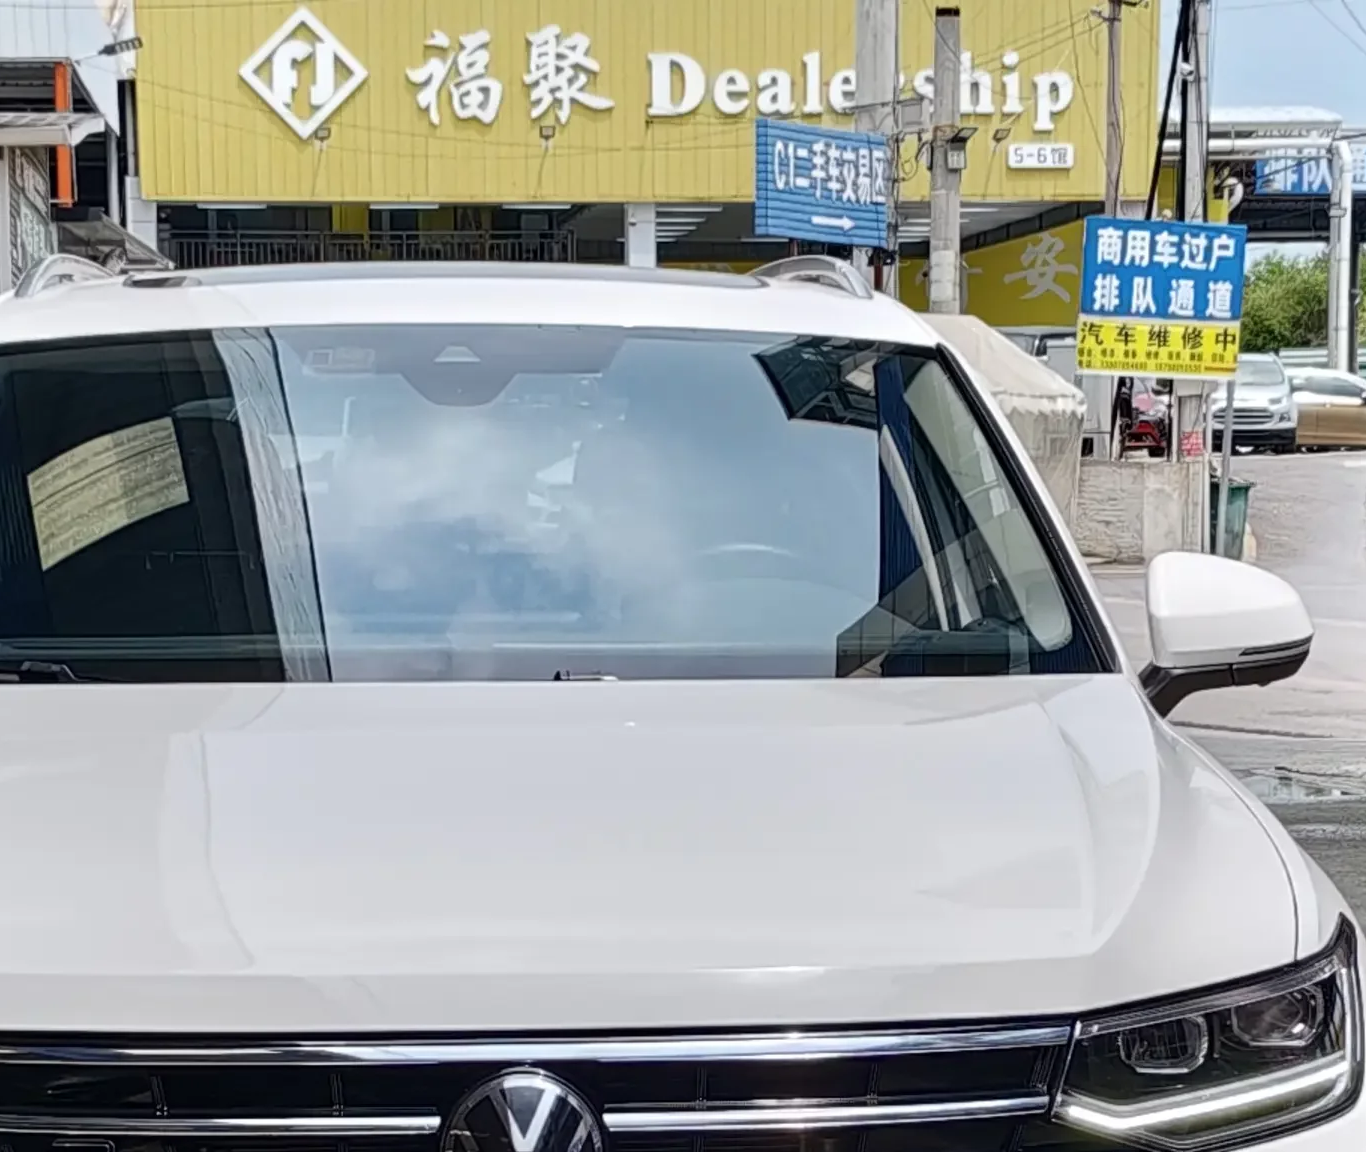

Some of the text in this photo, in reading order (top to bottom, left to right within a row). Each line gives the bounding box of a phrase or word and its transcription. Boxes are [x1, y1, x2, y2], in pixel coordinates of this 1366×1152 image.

[405, 24, 614, 126] 福聚
[647, 50, 1075, 131] Dealeship
[775, 140, 886, 206] C1二手车交易区
[1096, 226, 1236, 271] 商用车过户
[1092, 273, 1234, 318] 排队通道
[1080, 320, 1237, 352] 汽车维修中
